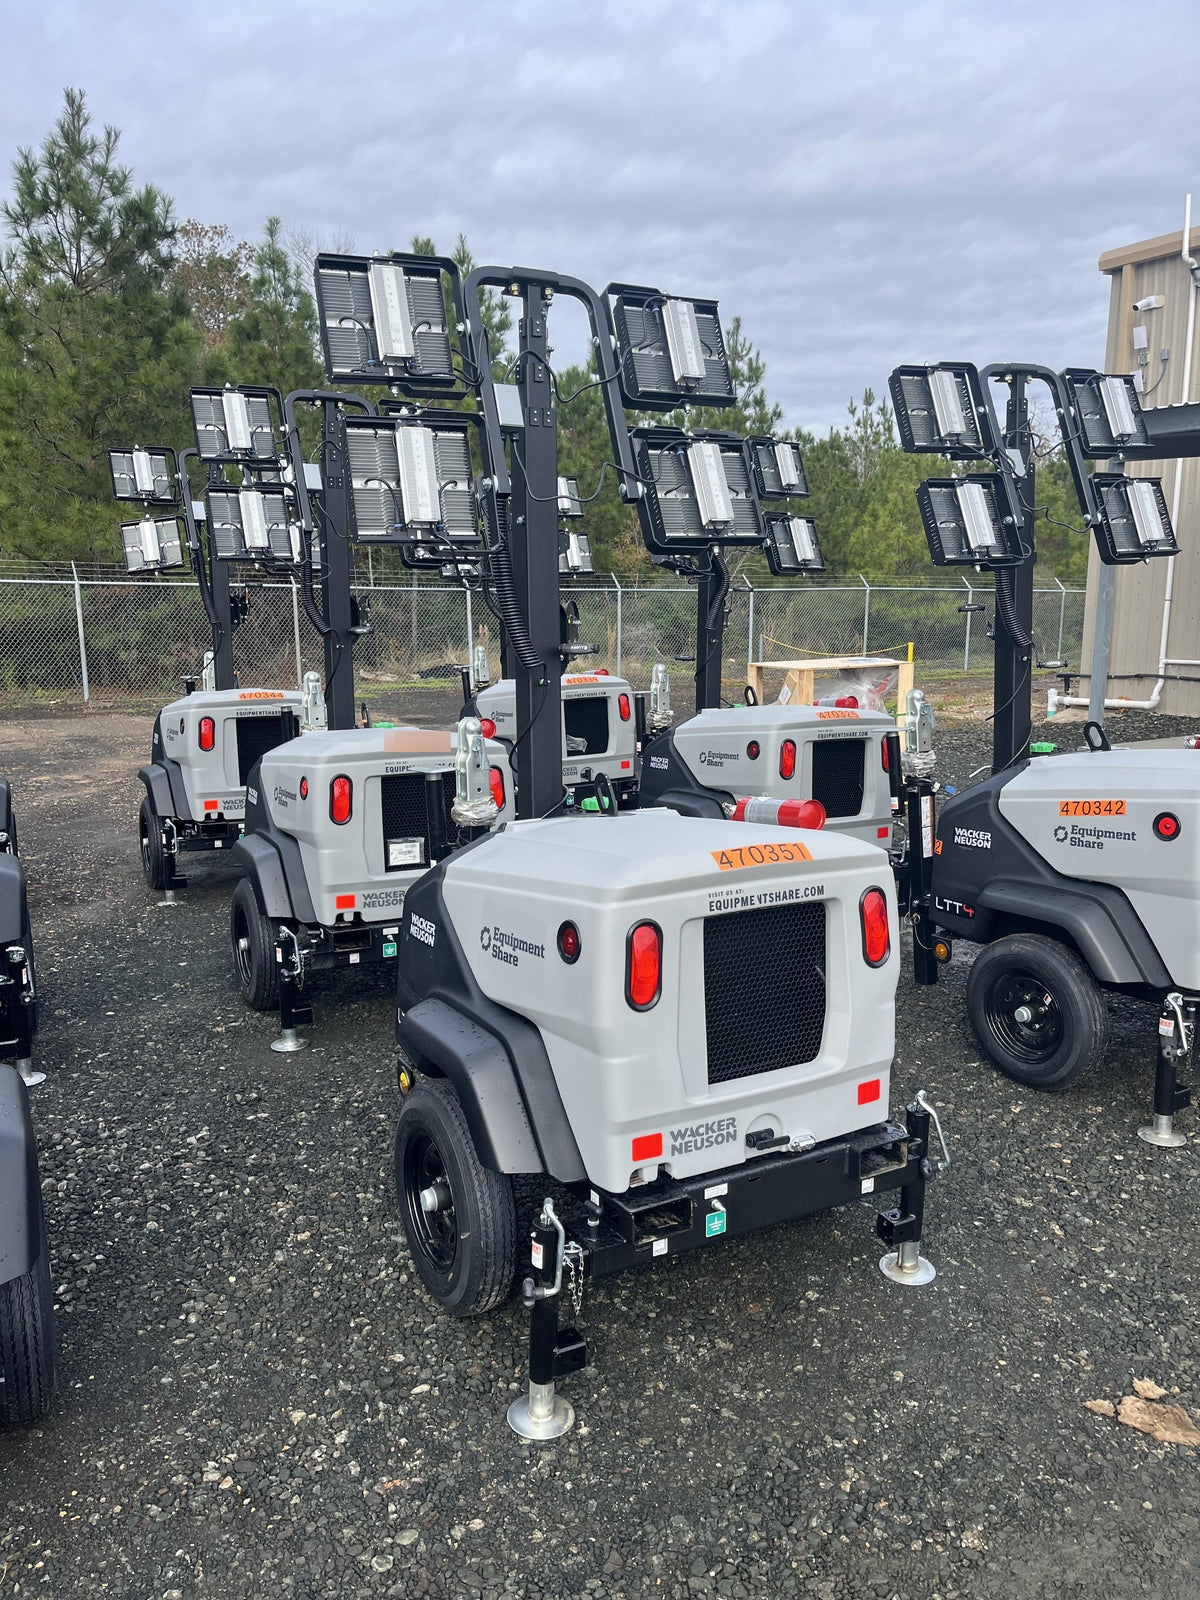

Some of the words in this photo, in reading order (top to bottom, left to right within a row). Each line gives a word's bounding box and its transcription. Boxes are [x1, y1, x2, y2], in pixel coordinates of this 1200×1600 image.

[817, 731, 868, 739] EQUIPMENTSHARE.COM
[706, 759, 724, 767] Share
[707, 751, 739, 761] Equipment
[1061, 800, 1124, 815] 470342
[954, 827, 991, 841] WACKER
[954, 836, 991, 849] NEUSON
[1070, 825, 1136, 841] Equipment
[1069, 837, 1104, 850] Share
[719, 843, 807, 868] 470351
[708, 891, 724, 899] VISIT
[709, 885, 825, 912] EQUIPMENTSHARE.COM
[935, 896, 975, 918] LTT4
[411, 911, 436, 935] WACKER
[409, 923, 436, 948] NEUSON
[493, 926, 546, 959] Equipment
[491, 943, 519, 967] Share
[669, 1117, 738, 1143] WACKER
[670, 1129, 738, 1157] NEUSON
